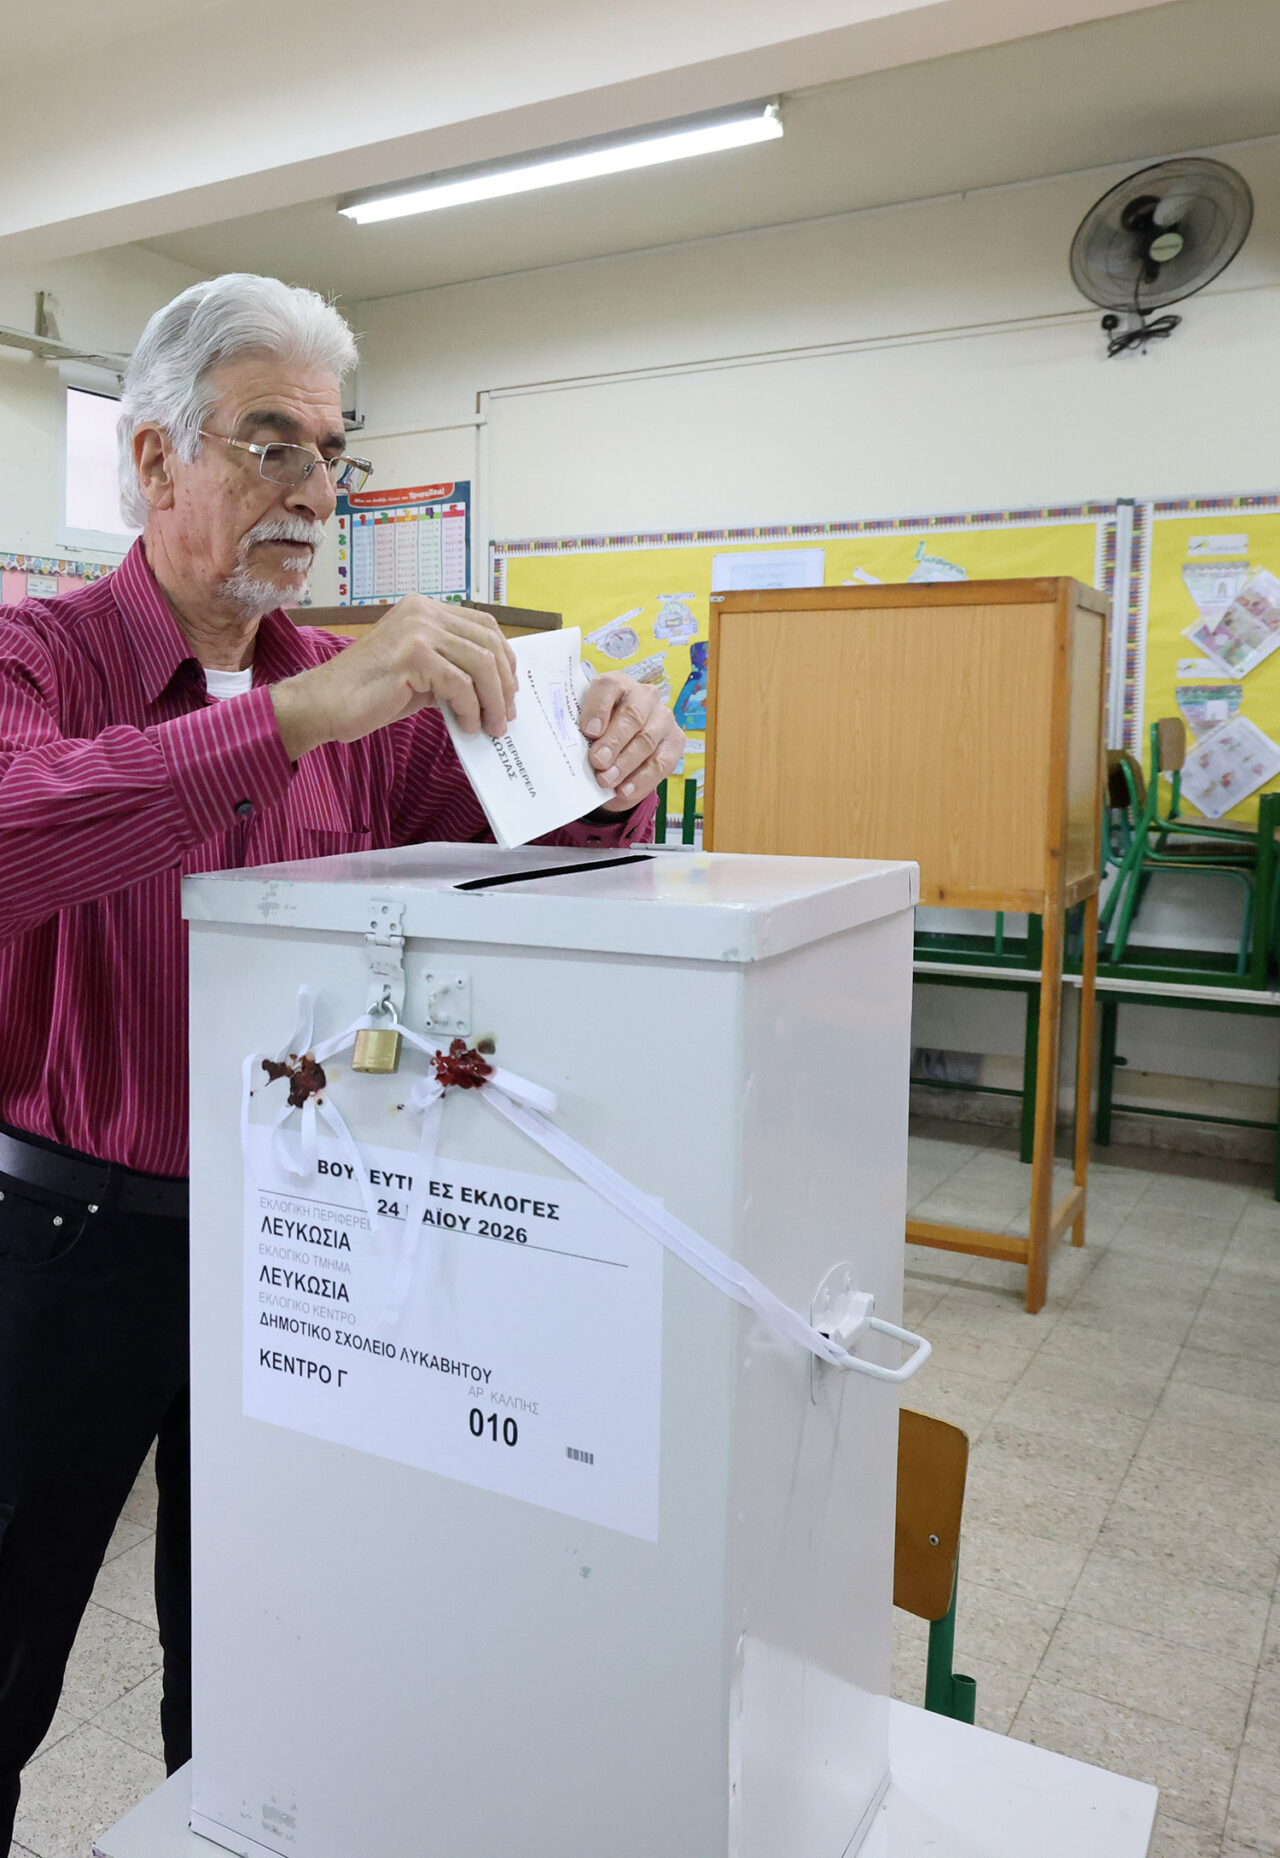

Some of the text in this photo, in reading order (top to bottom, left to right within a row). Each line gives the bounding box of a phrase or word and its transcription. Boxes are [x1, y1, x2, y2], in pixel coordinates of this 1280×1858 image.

[504, 736, 537, 798] ΠΕΡΙΦΕΡΕΙΑ
[318, 1160, 560, 1221] ΒΟΥΕΥΤΙΕΣ ΕΚΛΟΓΕΣ
[260, 1197, 372, 1231] ΕΚΛΟΓΙΚΗ ΠΕΡΙΦΕΡΕΙ
[377, 1199, 528, 1243] 24 ΑΪΟΥ 2026
[261, 1216, 351, 1251] ΛΕΥΚΩΣΙΑ
[259, 1243, 351, 1274] ΕΚΛΟΓΙΚΟ ΤΜΗΜΑ
[260, 1265, 349, 1303] ΛΕΥΚΩΣΙΑ
[259, 1291, 356, 1325] ΕΚΛΟΓΙΚΟ ΚΕΝΤΡΟ
[260, 1311, 492, 1384] ΔΗΜΟΤΙΚΟ ΣΧΟΛΕΙΟ ΛΥΚΑΒΗΤΟΥ
[260, 1348, 348, 1387] ΚΕΝΤΡΟ Γ
[490, 1391, 539, 1415] ΚΑΛΠΗΣ
[469, 1408, 518, 1447] 010
